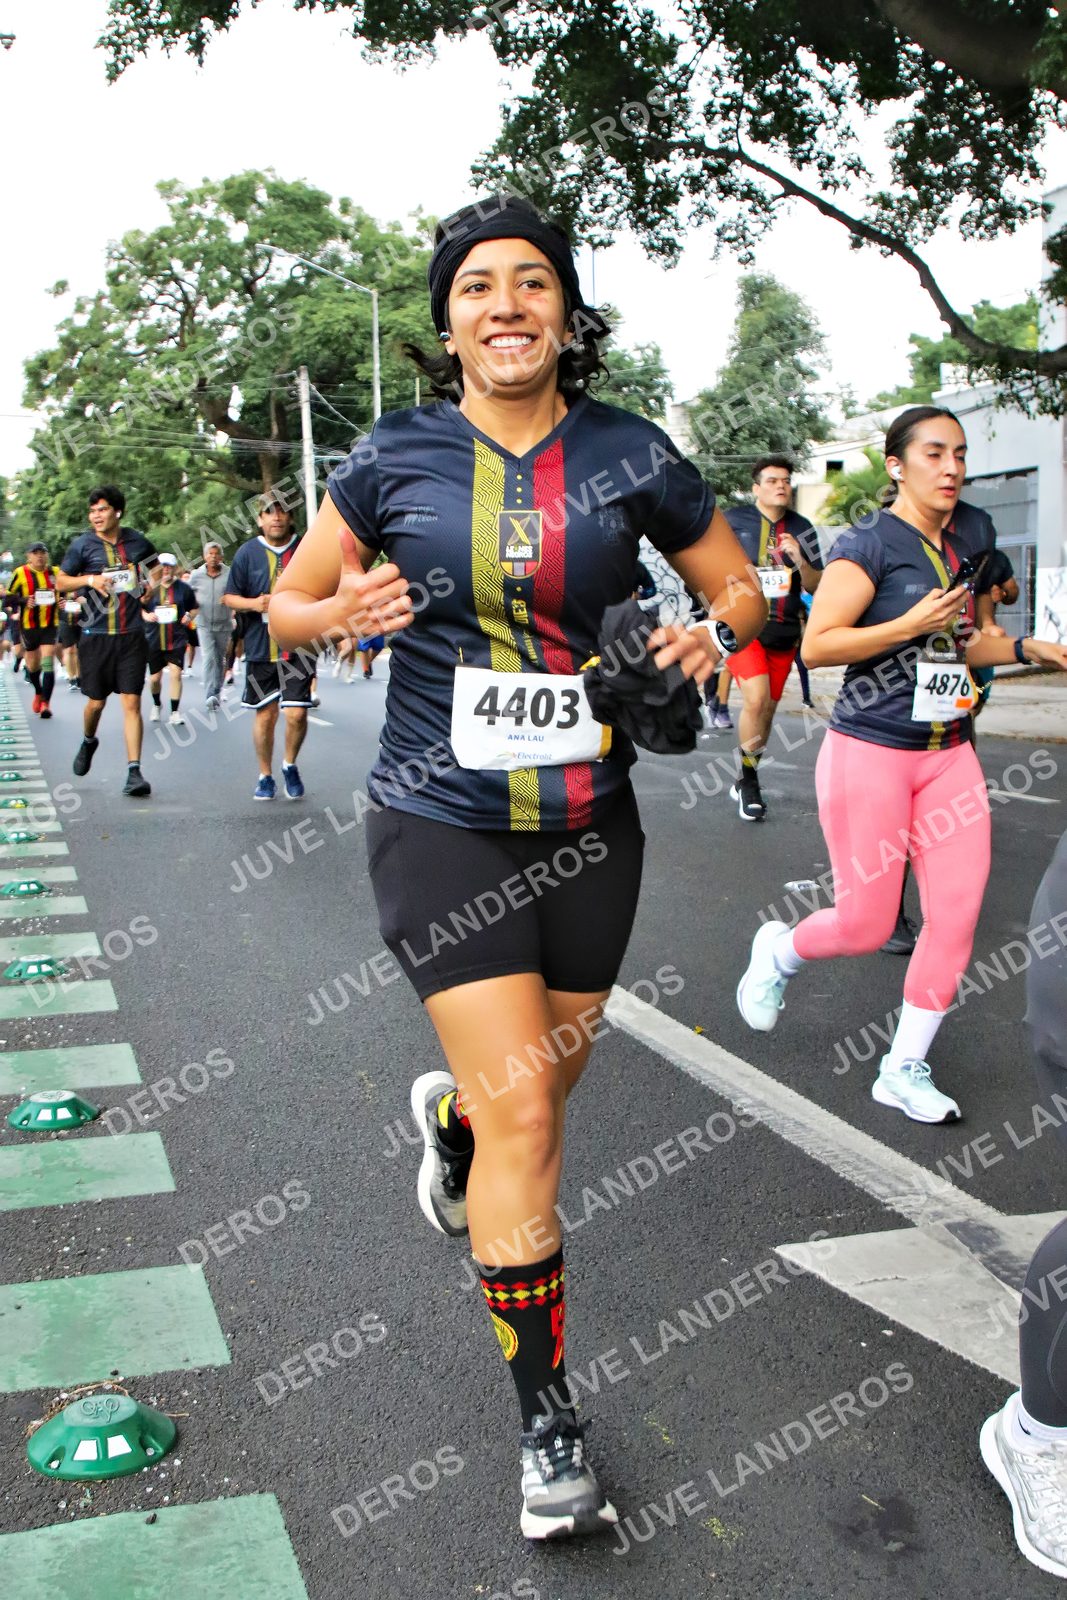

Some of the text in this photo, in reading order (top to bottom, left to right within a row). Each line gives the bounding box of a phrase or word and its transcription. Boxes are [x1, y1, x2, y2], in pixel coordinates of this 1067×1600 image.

[760, 575, 784, 585] 453
[925, 673, 970, 697] 4876
[474, 686, 580, 729] 4403
